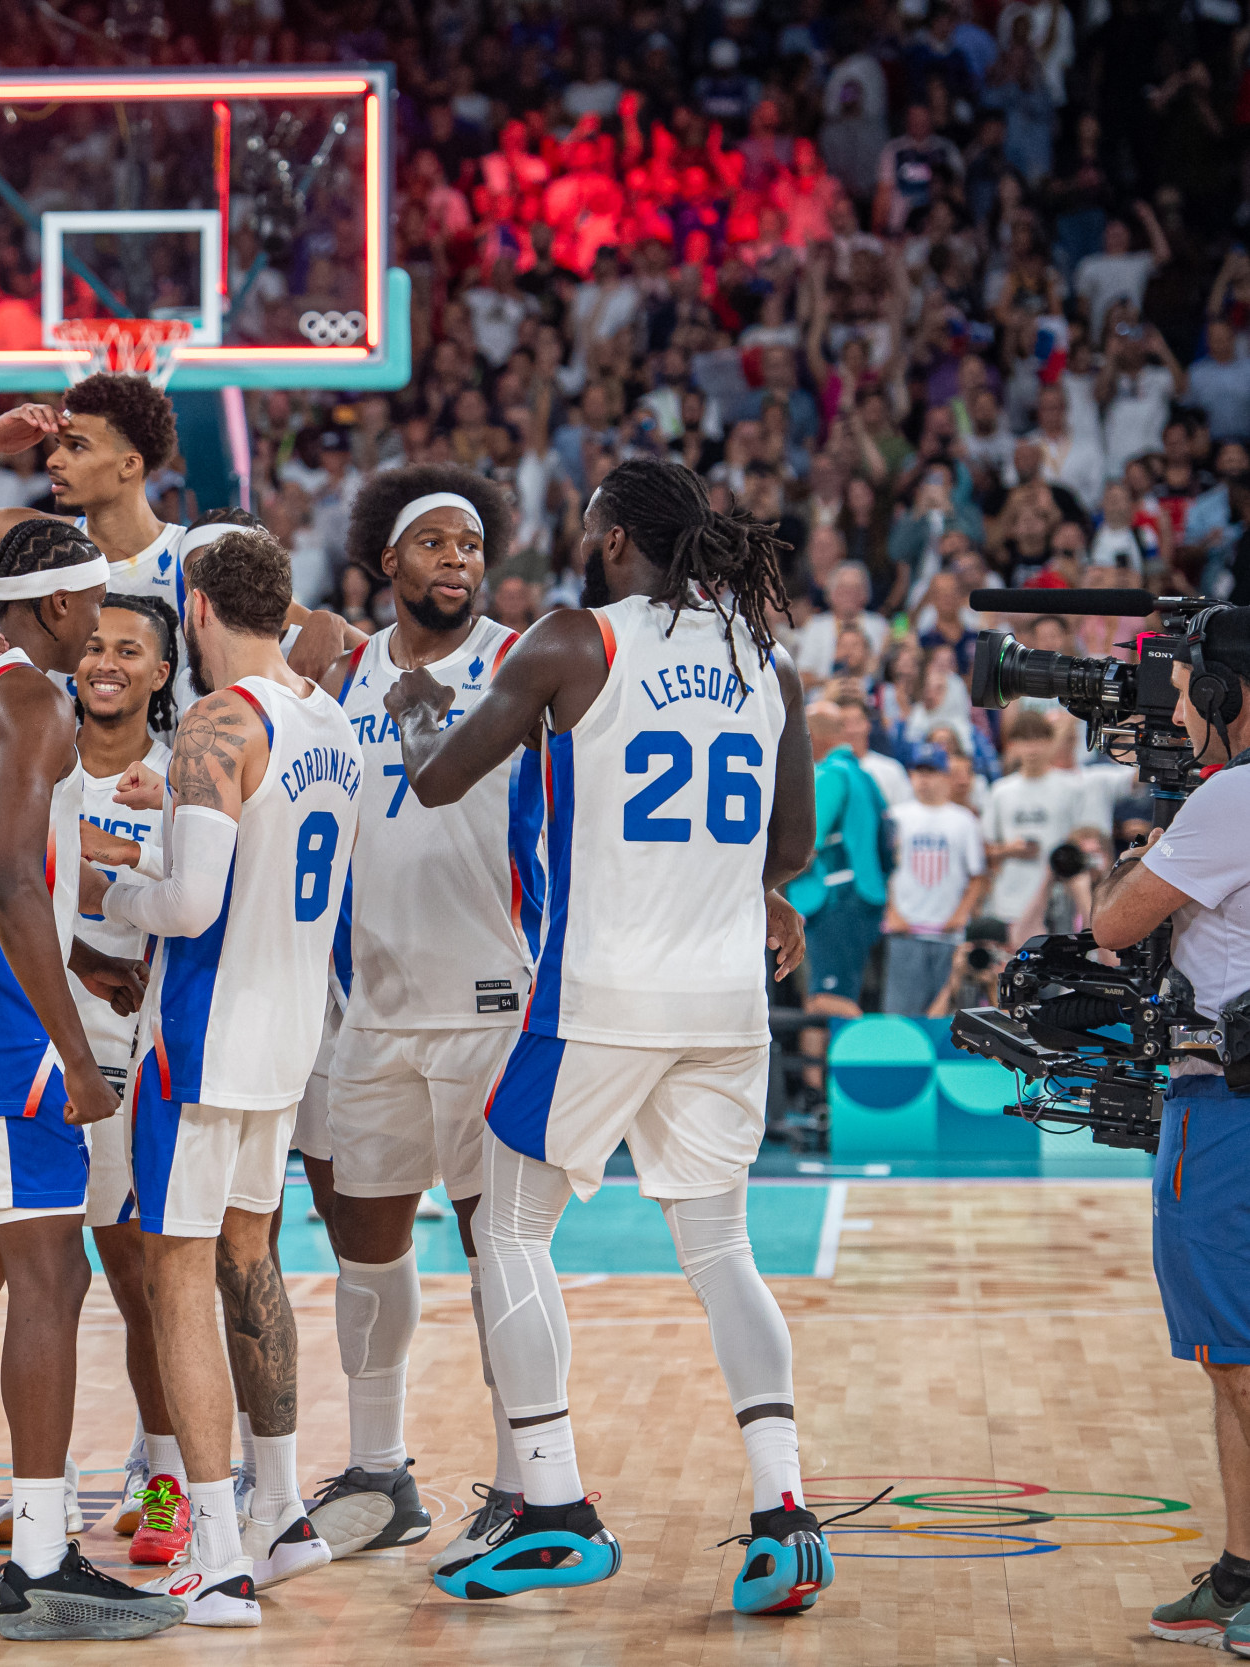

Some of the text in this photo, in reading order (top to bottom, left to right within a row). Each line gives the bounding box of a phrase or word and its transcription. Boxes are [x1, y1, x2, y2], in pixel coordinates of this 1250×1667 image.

[1148, 651, 1174, 659] SONY
[641, 664, 754, 714] LESSORT
[350, 709, 465, 745] FRAE
[281, 747, 360, 803] CORDINIER
[383, 764, 410, 818] 7
[623, 731, 763, 845] 26
[295, 811, 339, 922] 8
